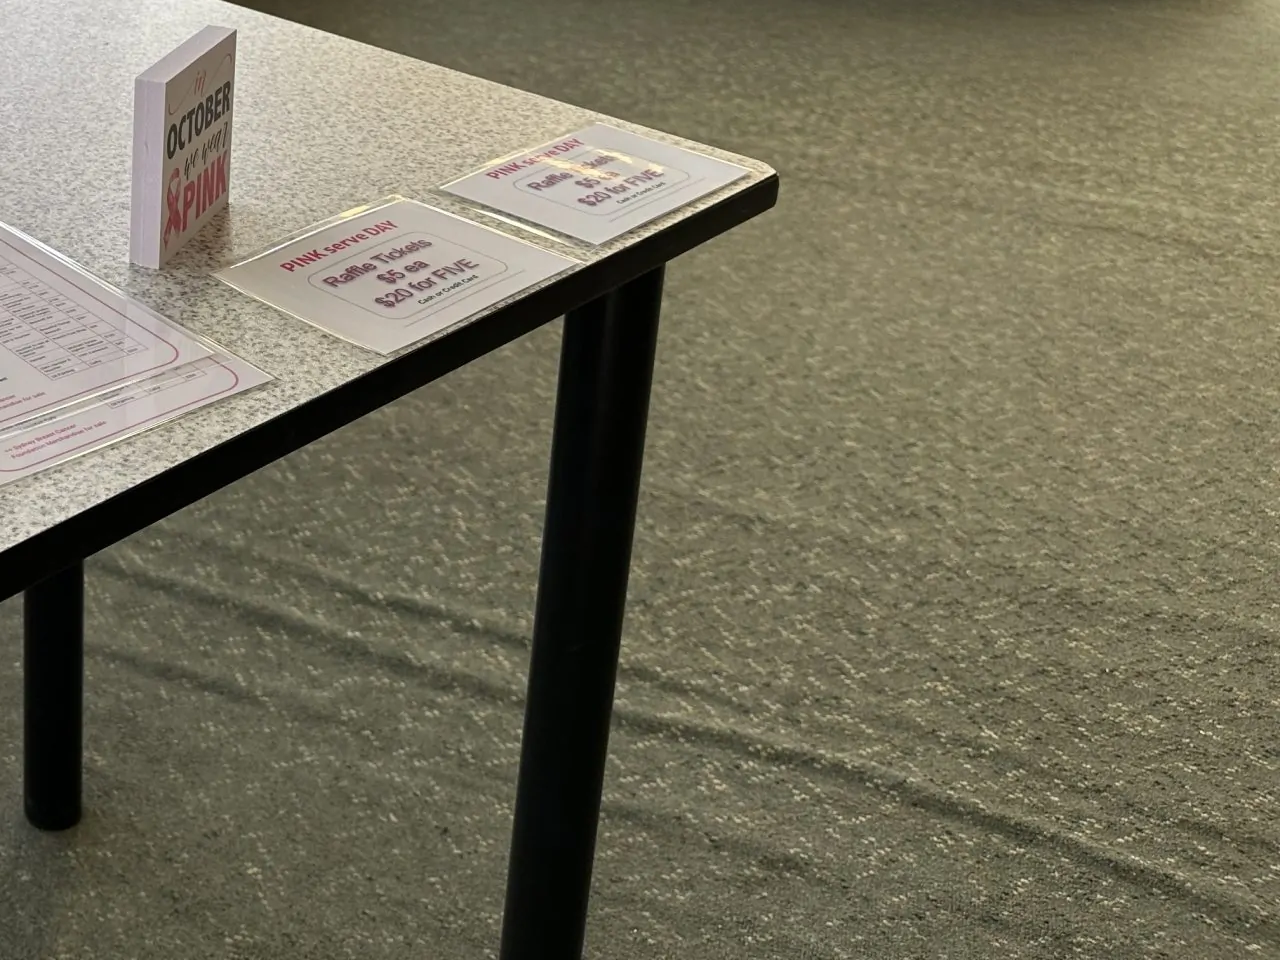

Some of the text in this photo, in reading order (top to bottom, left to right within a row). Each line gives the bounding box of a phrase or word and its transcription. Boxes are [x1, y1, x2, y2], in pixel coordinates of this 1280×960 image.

[166, 80, 231, 160] OCTOBER
[485, 161, 525, 180] PINK
[555, 137, 585, 153] DAY
[182, 149, 229, 233] PINK
[527, 171, 575, 191] Raffle
[574, 177, 601, 189] $5
[577, 167, 665, 207] $20 for FIVE
[280, 220, 399, 272] PINK serve DAY
[322, 239, 433, 287] Raffle Tickets
[375, 258, 480, 308] $20 for FIVE
[376, 259, 431, 285] $5 ea
[417, 295, 436, 305] Cash
[441, 281, 464, 293] Credit
[461, 274, 479, 283] Card
[11, 444, 46, 459] Foundation
[46, 430, 84, 446] Merchandise
[13, 440, 36, 450] Sydney
[35, 432, 55, 442] Breast
[55, 424, 76, 434] Cancer
